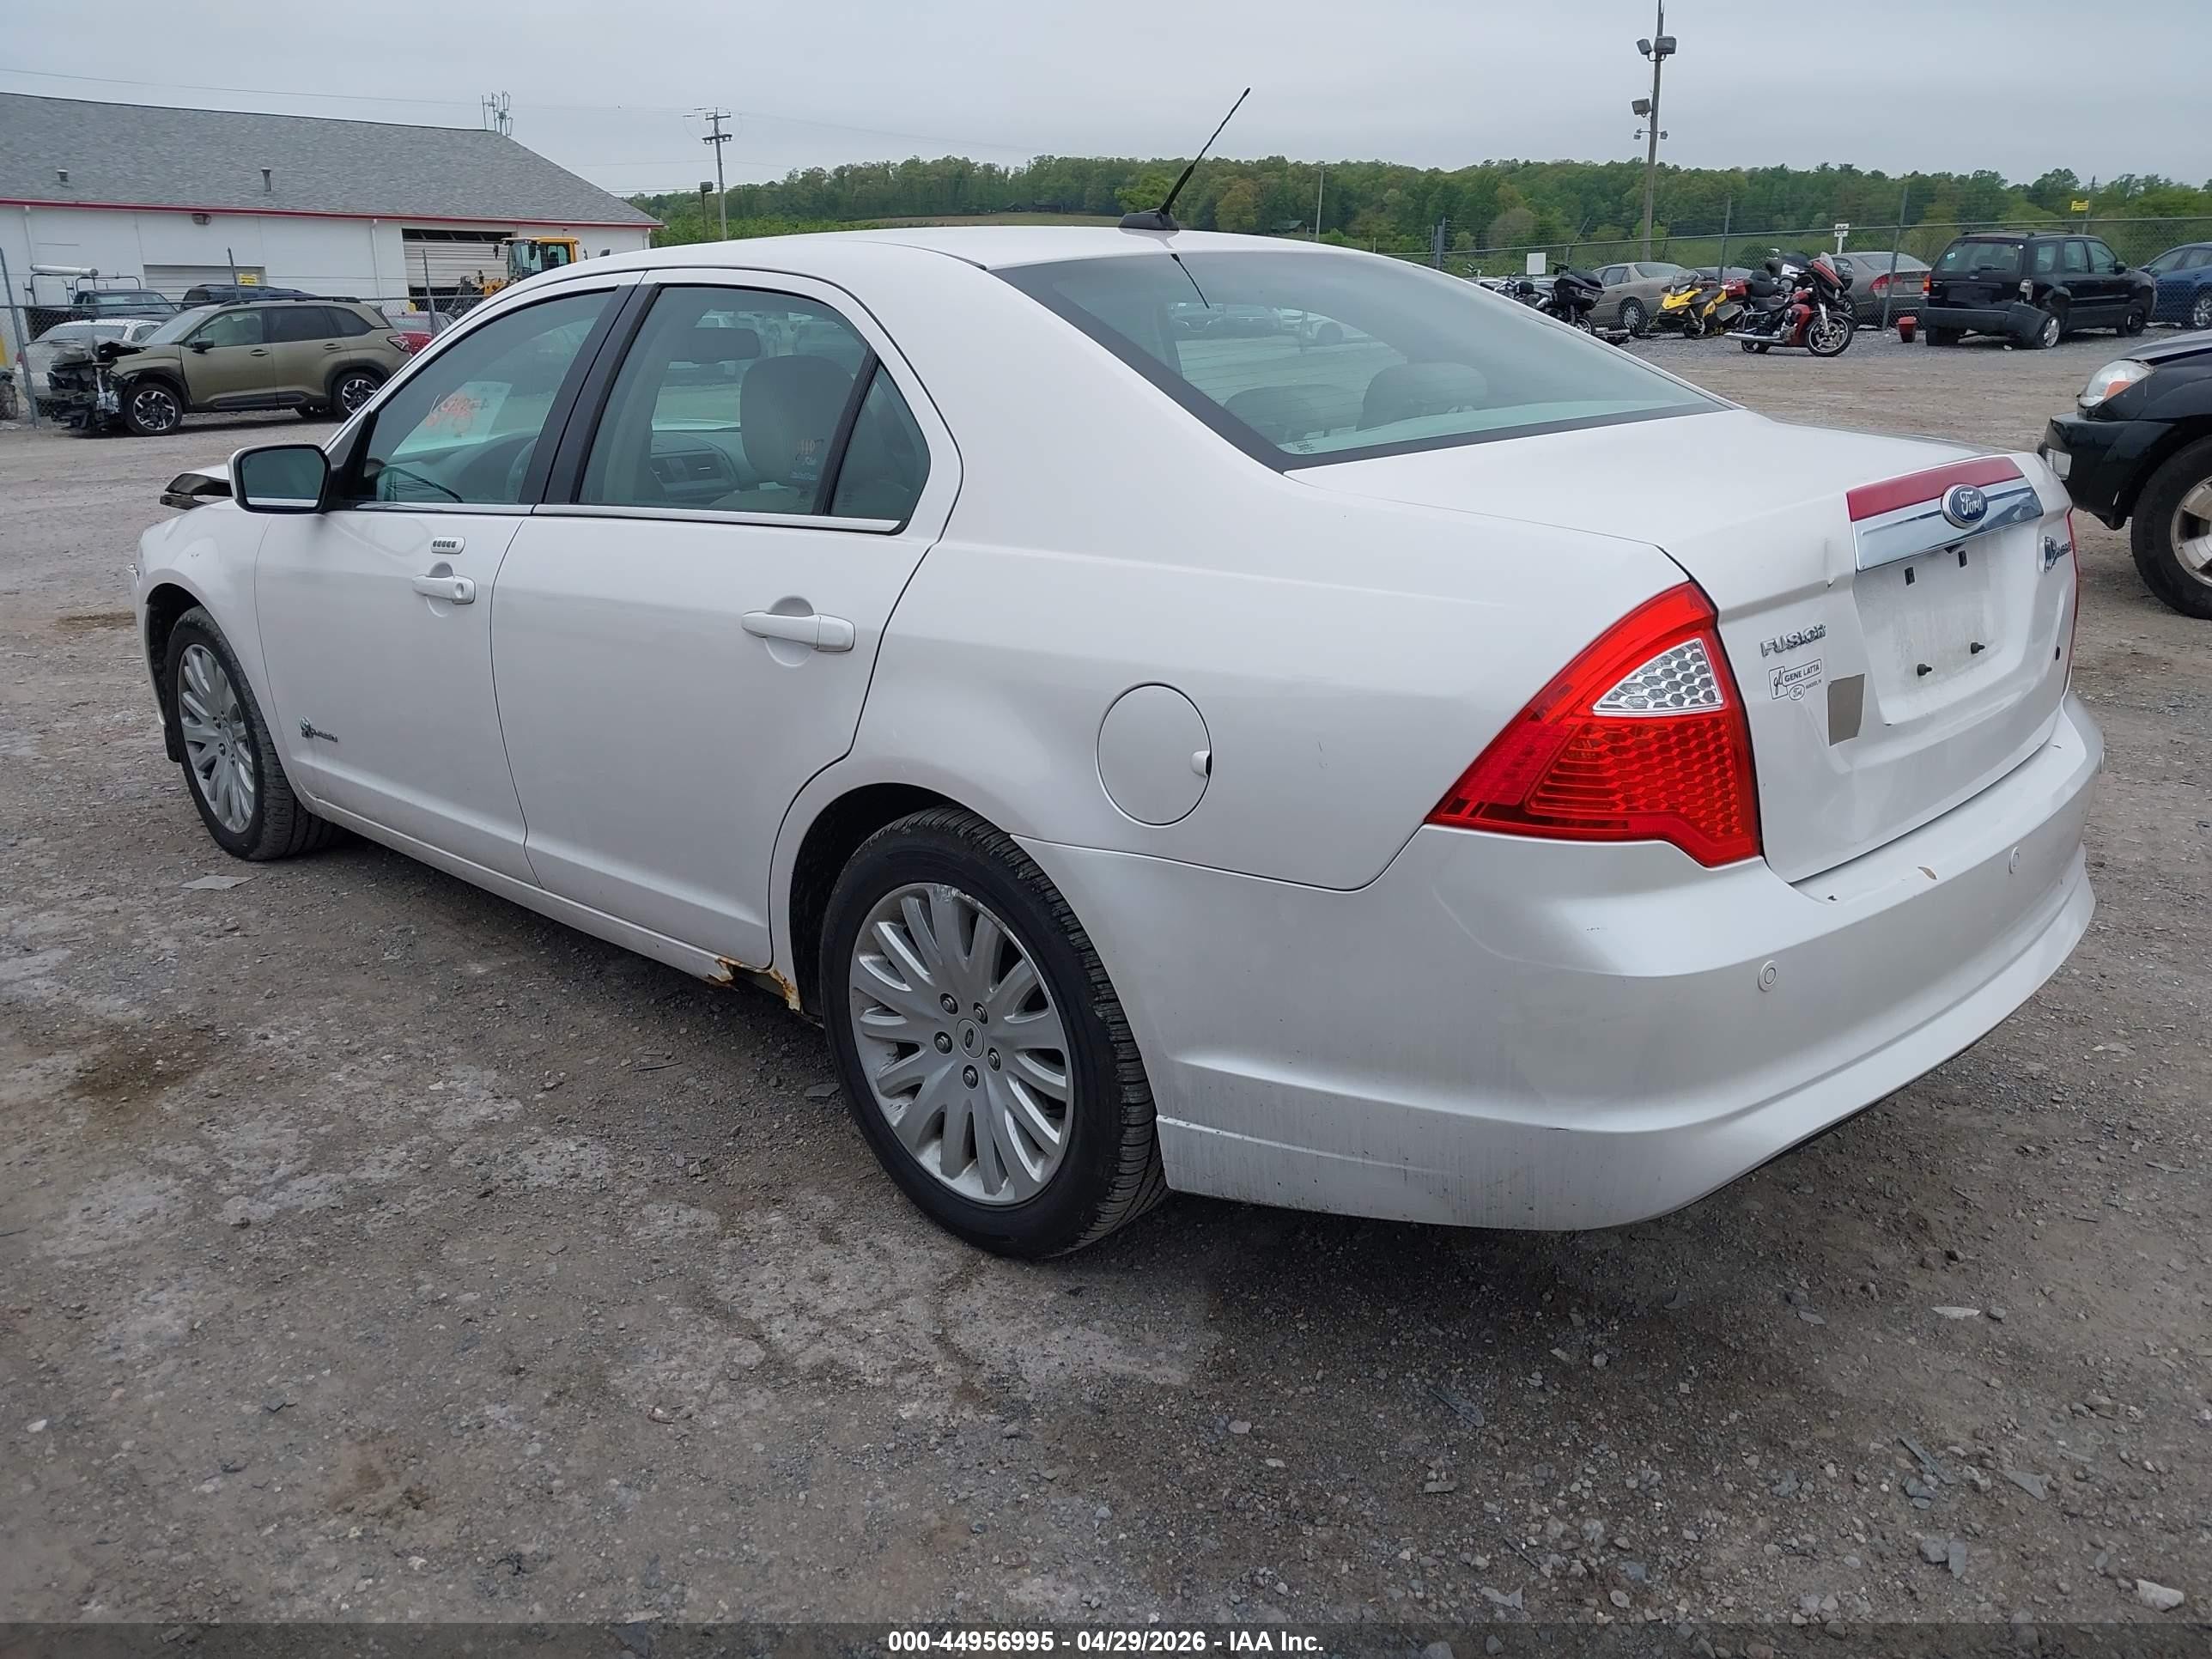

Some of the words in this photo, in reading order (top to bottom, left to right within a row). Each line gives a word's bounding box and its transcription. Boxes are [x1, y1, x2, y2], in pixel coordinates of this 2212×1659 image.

[1959, 490, 1983, 515] Ford
[1760, 624, 1826, 658] FUSION
[1784, 671, 1802, 683] GENE
[1804, 664, 1820, 676] LATTA
